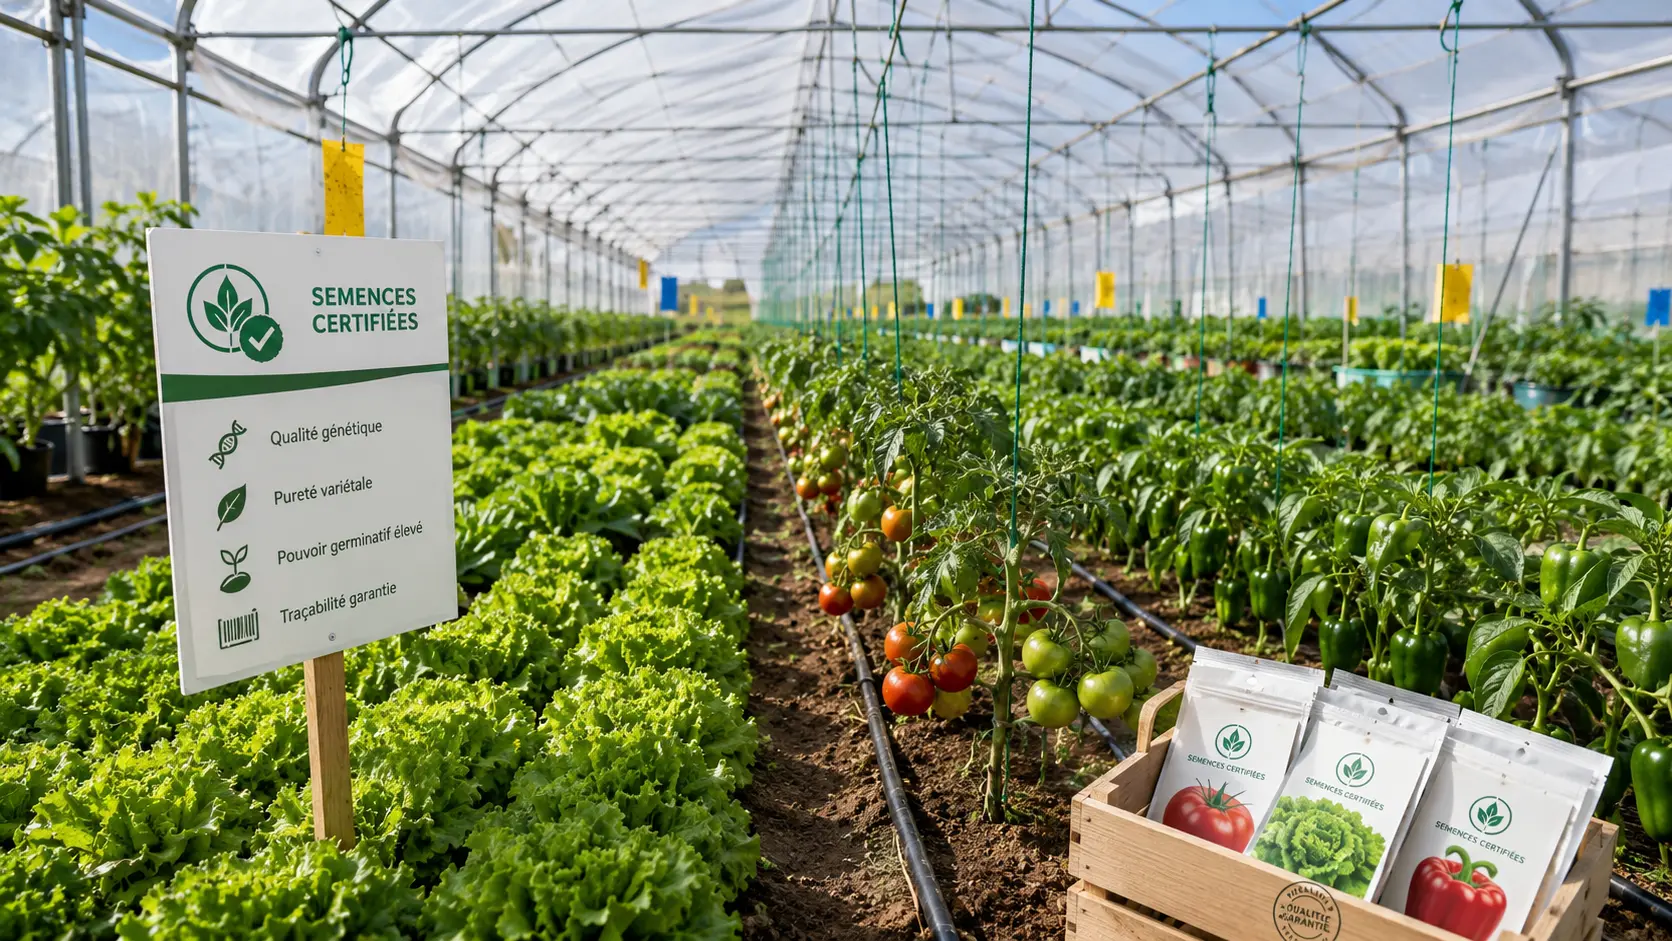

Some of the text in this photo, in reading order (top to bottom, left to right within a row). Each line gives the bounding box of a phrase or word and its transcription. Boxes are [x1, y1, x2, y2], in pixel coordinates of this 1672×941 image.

[312, 286, 417, 306] SEMENCES
[312, 308, 419, 334] CERTIFIÉES
[270, 421, 382, 447] Qualité génétique
[274, 476, 373, 506] Pureté variétale
[277, 521, 423, 565] Pouvoir germinatif élevé
[280, 582, 397, 624] Traçabilité garantie
[1187, 753, 1225, 770] SEMENCES
[1304, 776, 1344, 796] SEMENCES
[1434, 820, 1526, 864] SEMENCES CERTIFIÉES
